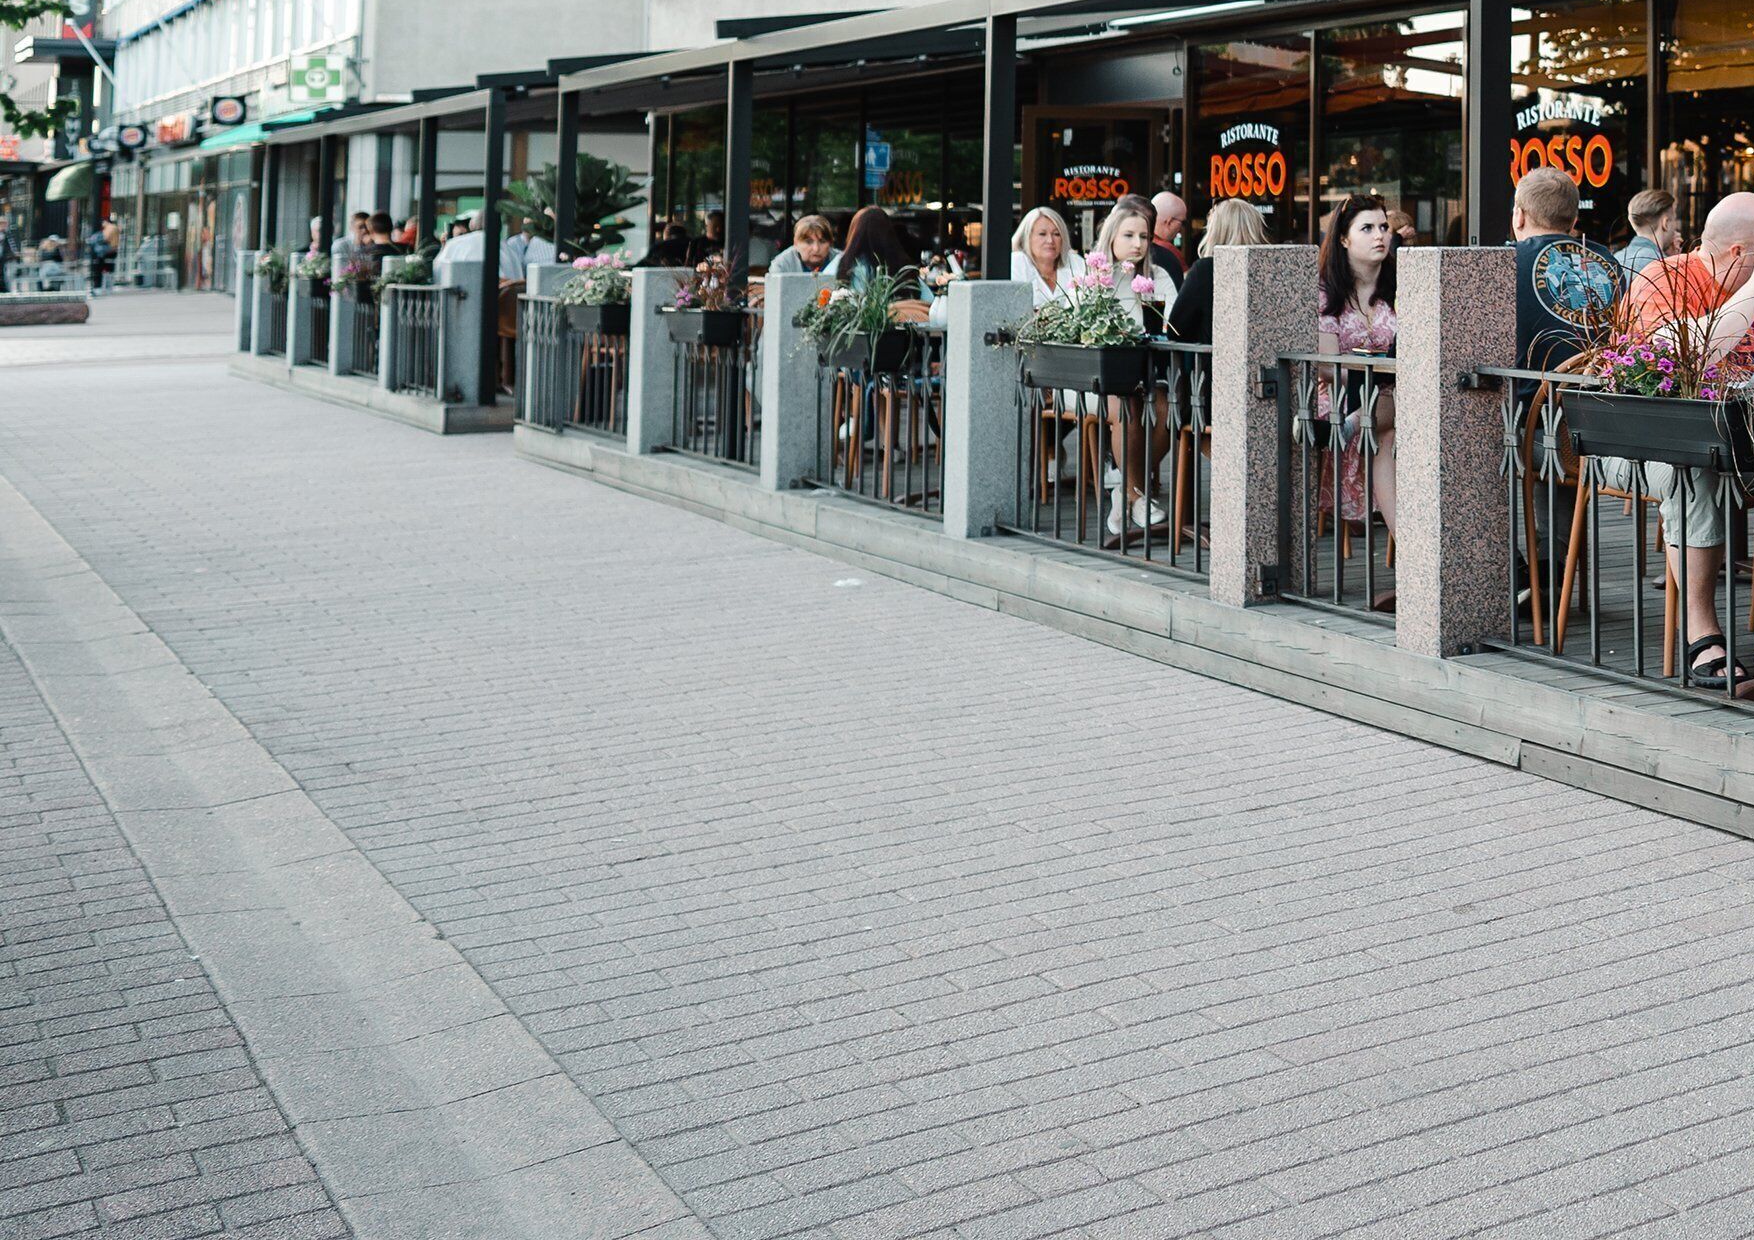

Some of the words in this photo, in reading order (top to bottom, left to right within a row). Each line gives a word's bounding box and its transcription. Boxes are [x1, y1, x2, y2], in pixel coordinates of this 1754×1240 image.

[1516, 100, 1602, 131] RISTORANTE
[1220, 122, 1279, 149] RISTORANTE
[1063, 165, 1121, 177] RISTORANTE
[1210, 151, 1287, 197] ROSSO
[1055, 177, 1130, 200] ROSSO
